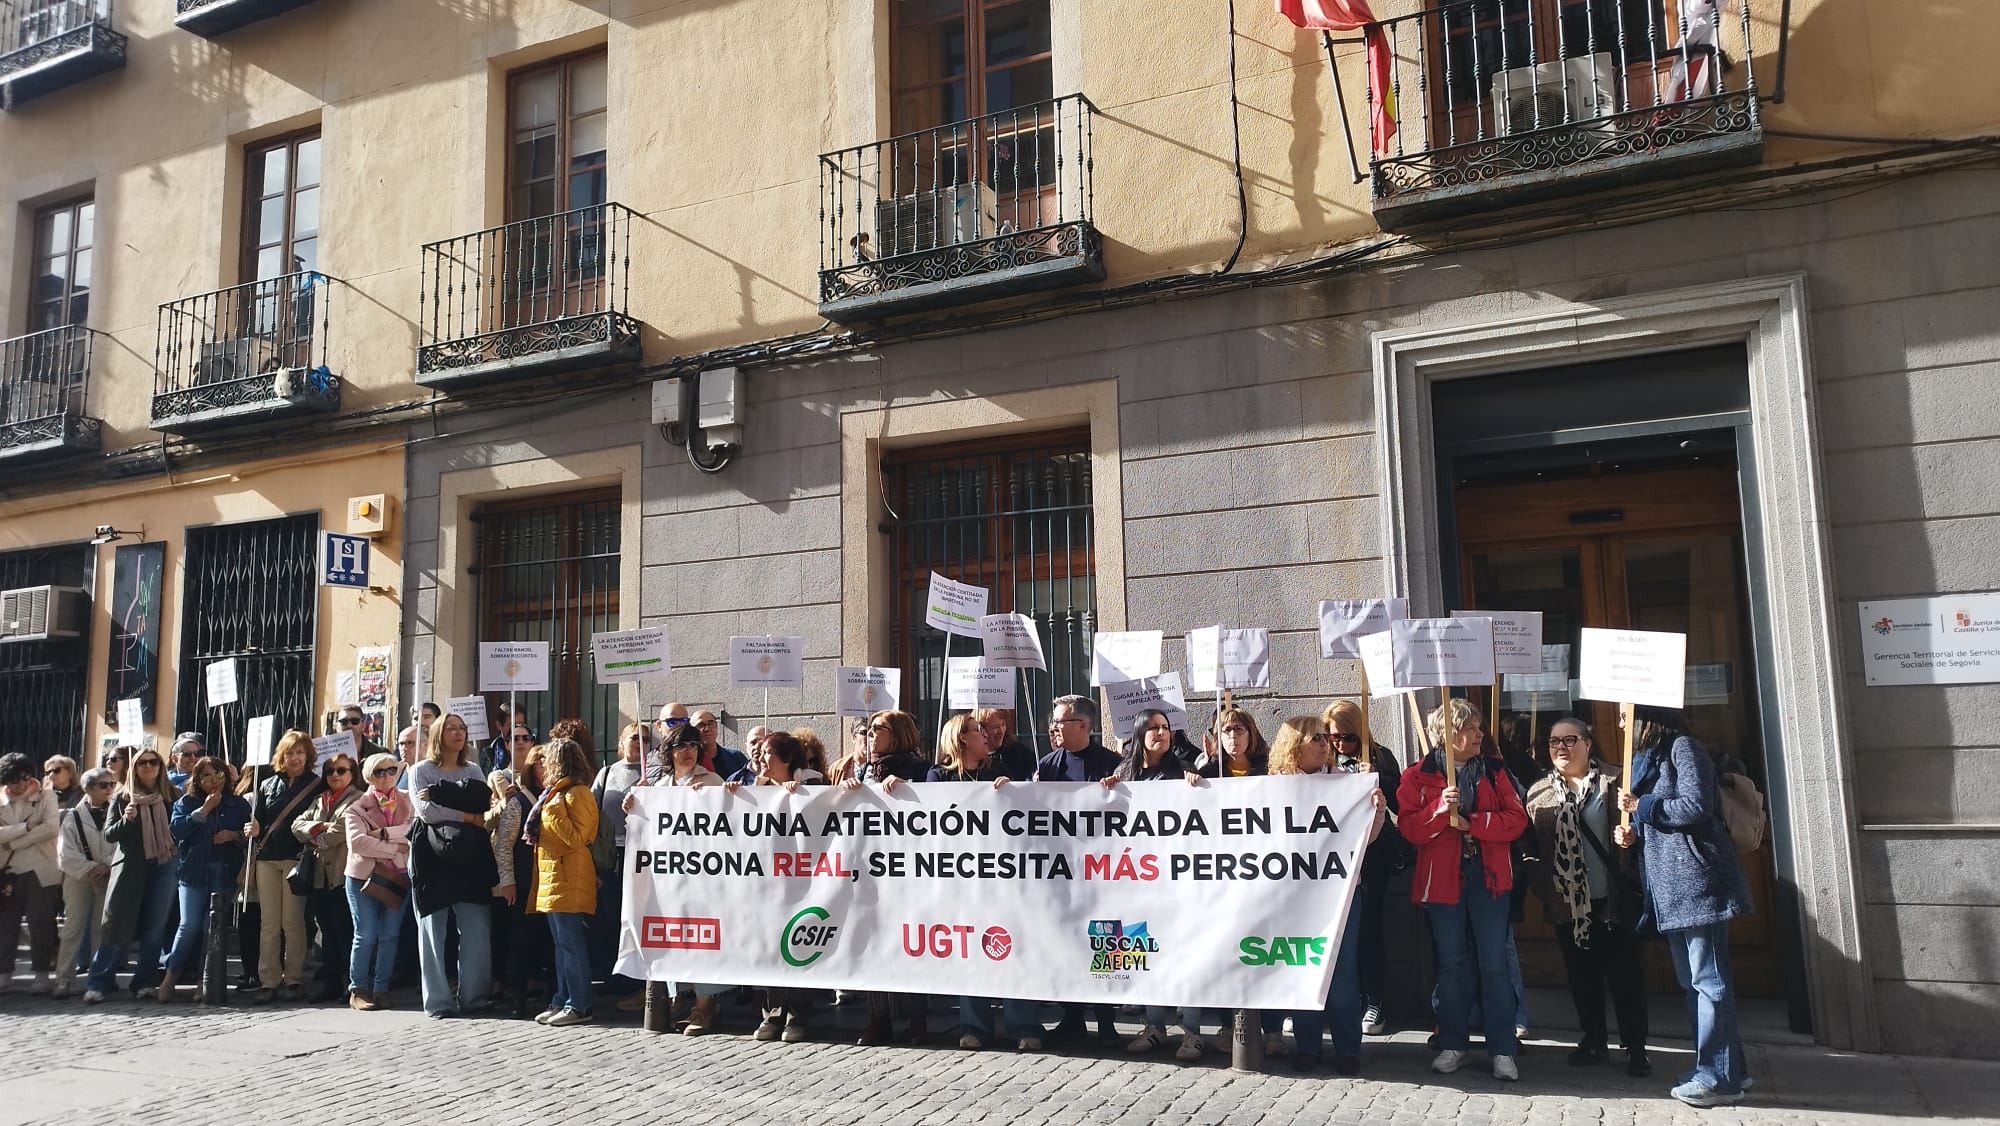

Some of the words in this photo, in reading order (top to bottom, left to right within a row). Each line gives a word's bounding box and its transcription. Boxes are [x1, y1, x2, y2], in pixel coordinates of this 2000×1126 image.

[635, 632, 664, 641] CENTRADA
[1874, 651, 1910, 661] Gerencia
[1913, 649, 1954, 659] Territorial
[1957, 648, 1968, 657] de
[1900, 660, 1934, 669] Sociales
[1949, 659, 1981, 669] Segovia
[1113, 692, 1135, 701] CUIDAR
[1148, 685, 1176, 694] PERSONA
[657, 812, 733, 837] PARA
[743, 812, 810, 838] UNA
[821, 804, 990, 837] ATENCIÓN
[1001, 809, 1209, 837] CENTRADA
[1221, 806, 1272, 835] EN
[1285, 805, 1340, 835] LA
[635, 850, 765, 877] PERSONA
[773, 852, 860, 882] REAL,
[869, 852, 909, 878] SE
[915, 852, 1073, 880] NECESITA
[1084, 847, 1160, 881] MÁS
[1171, 850, 1354, 881] PERSONA
[647, 922, 716, 944] CCOO
[791, 925, 838, 947] CSIF
[903, 923, 975, 959] UGT
[1090, 936, 1159, 953] USCAL
[1093, 954, 1151, 972] SAECYL
